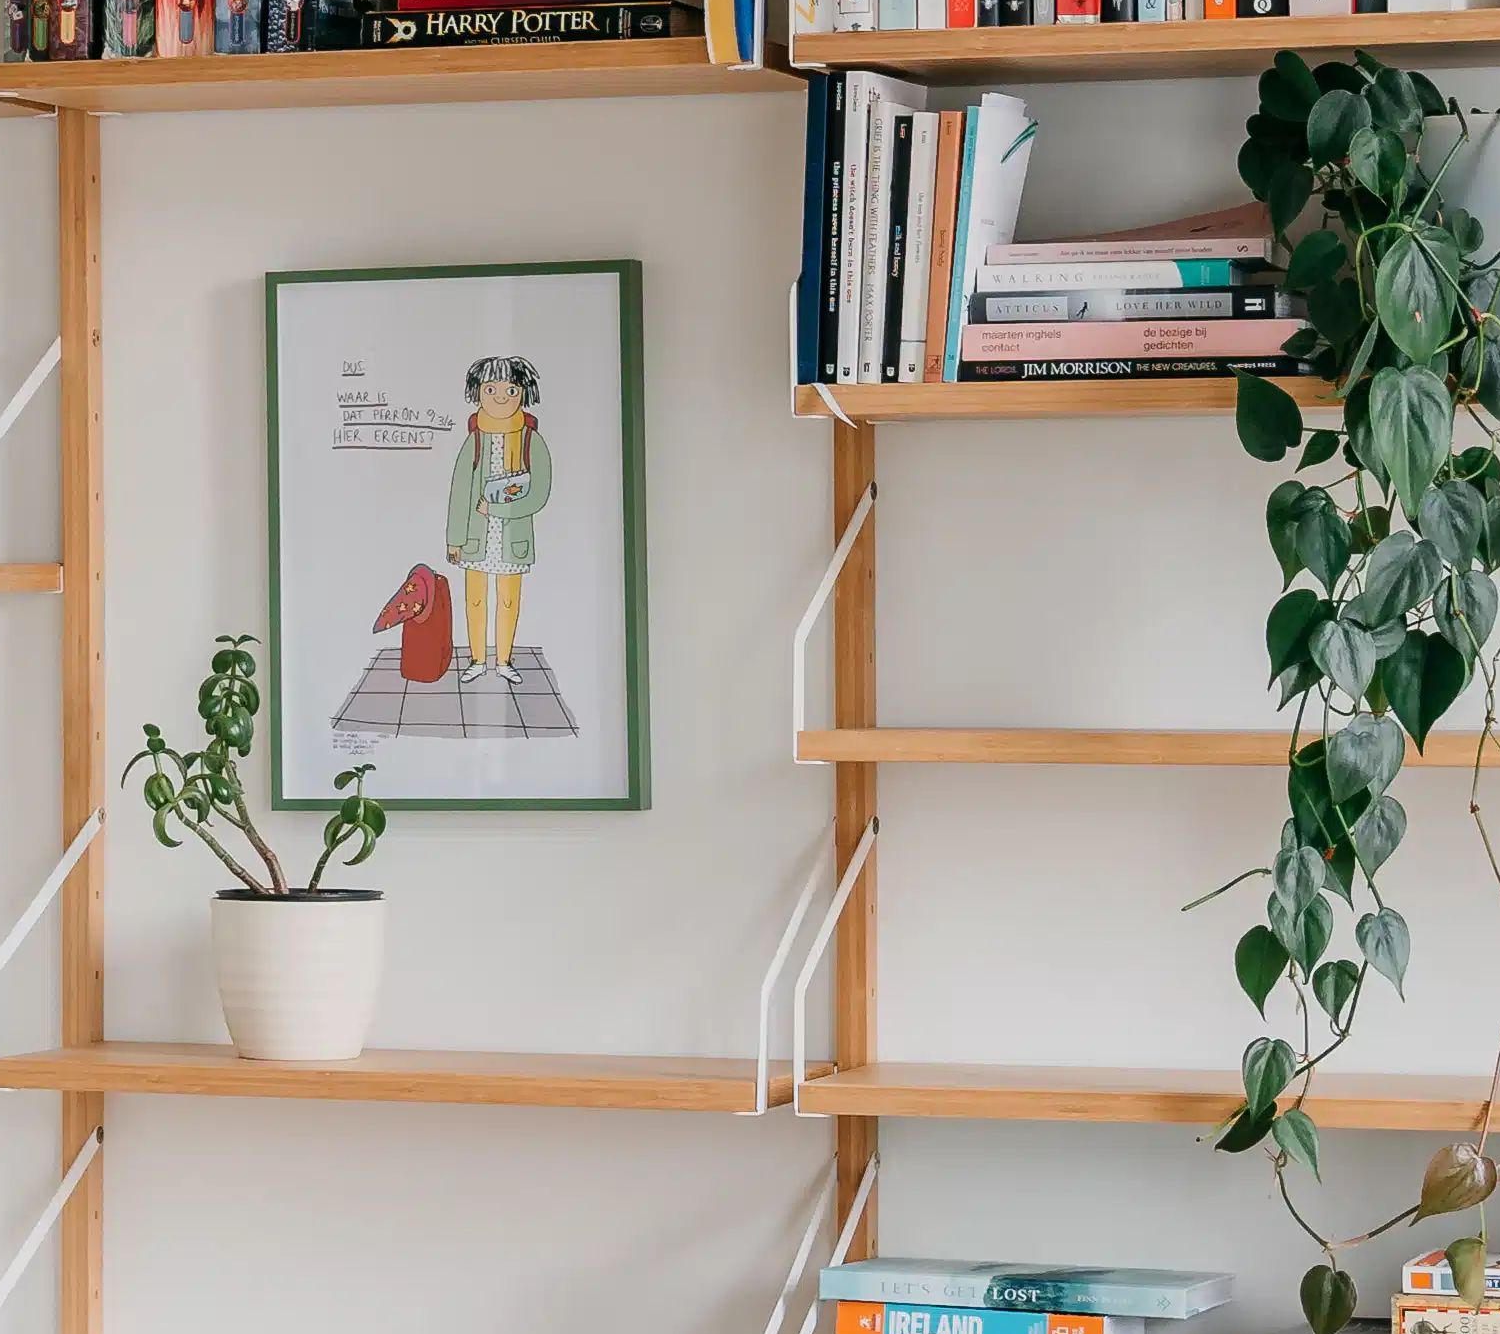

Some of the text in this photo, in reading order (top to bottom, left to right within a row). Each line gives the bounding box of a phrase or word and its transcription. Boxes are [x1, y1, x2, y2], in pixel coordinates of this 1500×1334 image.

[427, 8, 599, 36] HARRY POTTER
[873, 118, 882, 141] GRIEF
[993, 273, 1084, 284] WALKING
[829, 278, 837, 296] this
[995, 304, 1059, 315] ATTICUS
[1116, 299, 1223, 312] LOVE HER WILD
[982, 329, 1062, 341] maarten inghels
[1143, 327, 1207, 340] de bezige bij
[982, 342, 1020, 353] contact
[1143, 340, 1194, 352] gedichten
[1021, 362, 1132, 379] JIM MORRISON
[1151, 363, 1169, 371] NEW
[337, 391, 388, 403] WAAR IS
[343, 408, 436, 422] DAT PERRON 9
[333, 428, 362, 444] HIER
[992, 1286, 1041, 1302] LOST
